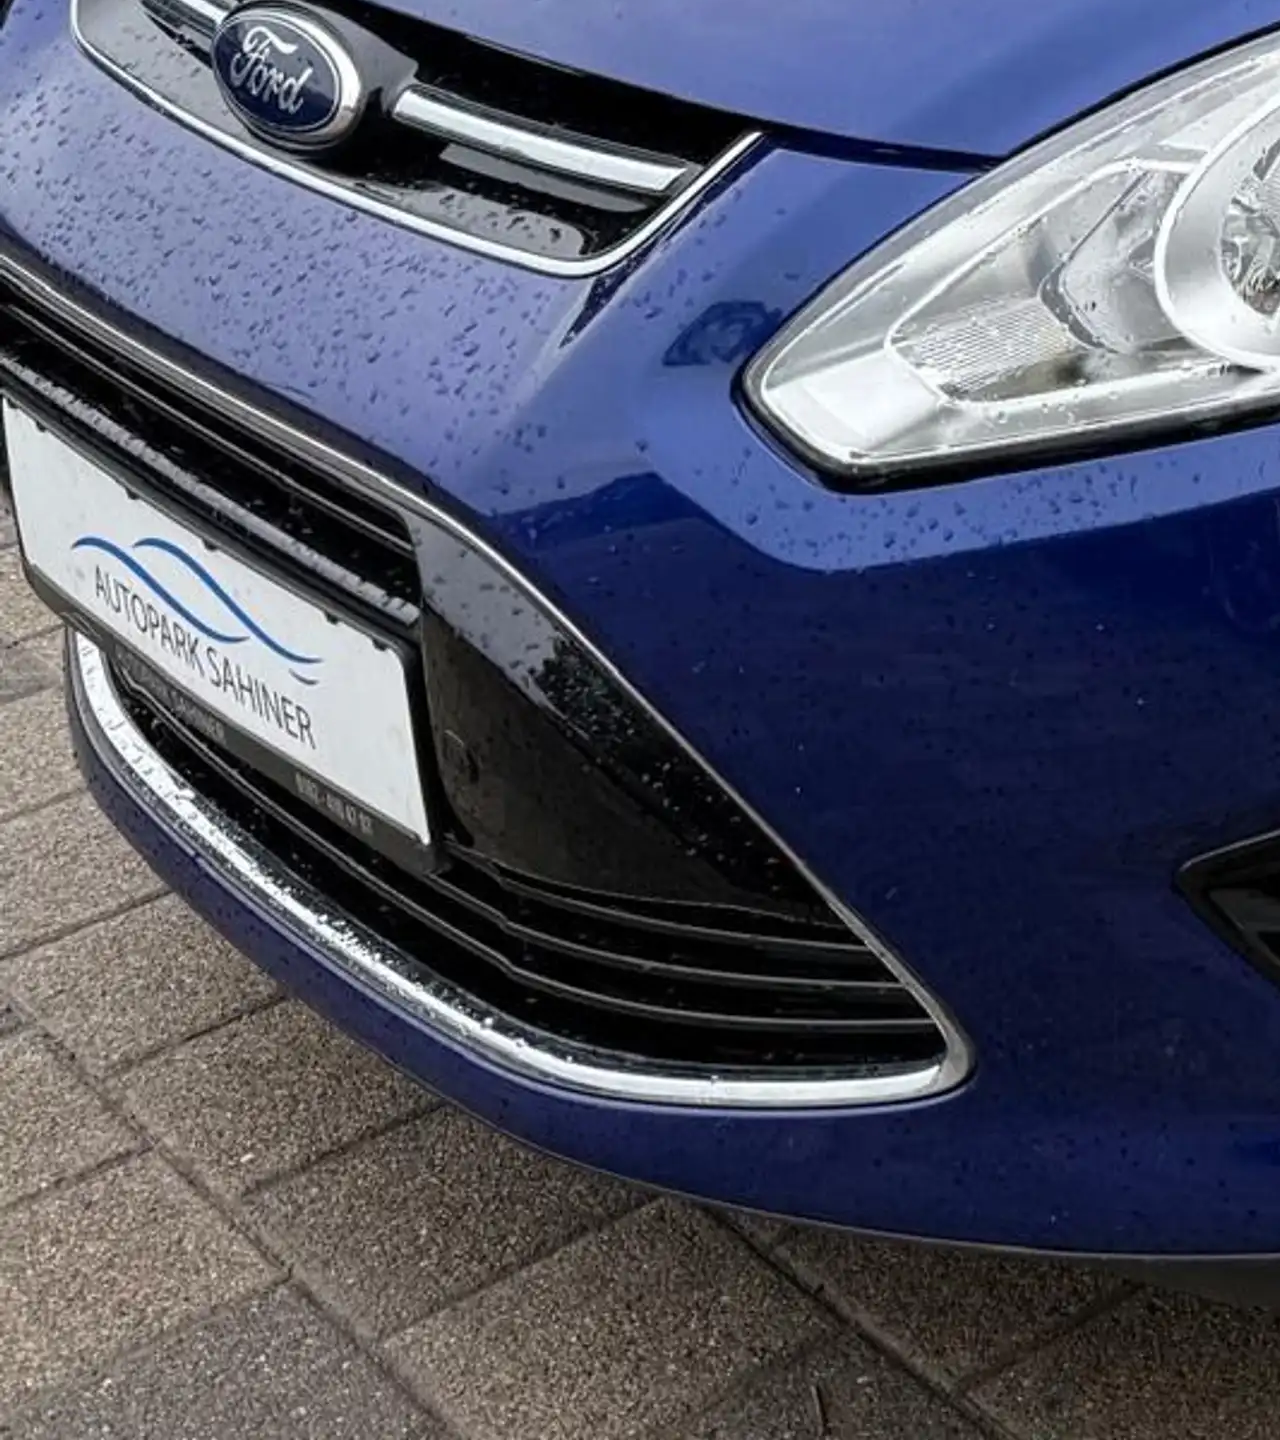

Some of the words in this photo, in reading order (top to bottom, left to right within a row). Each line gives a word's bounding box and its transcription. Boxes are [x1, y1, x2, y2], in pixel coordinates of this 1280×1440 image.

[230, 25, 314, 114] Ford
[95, 565, 205, 679] AUTOPARK
[206, 645, 316, 750] SAHINER
